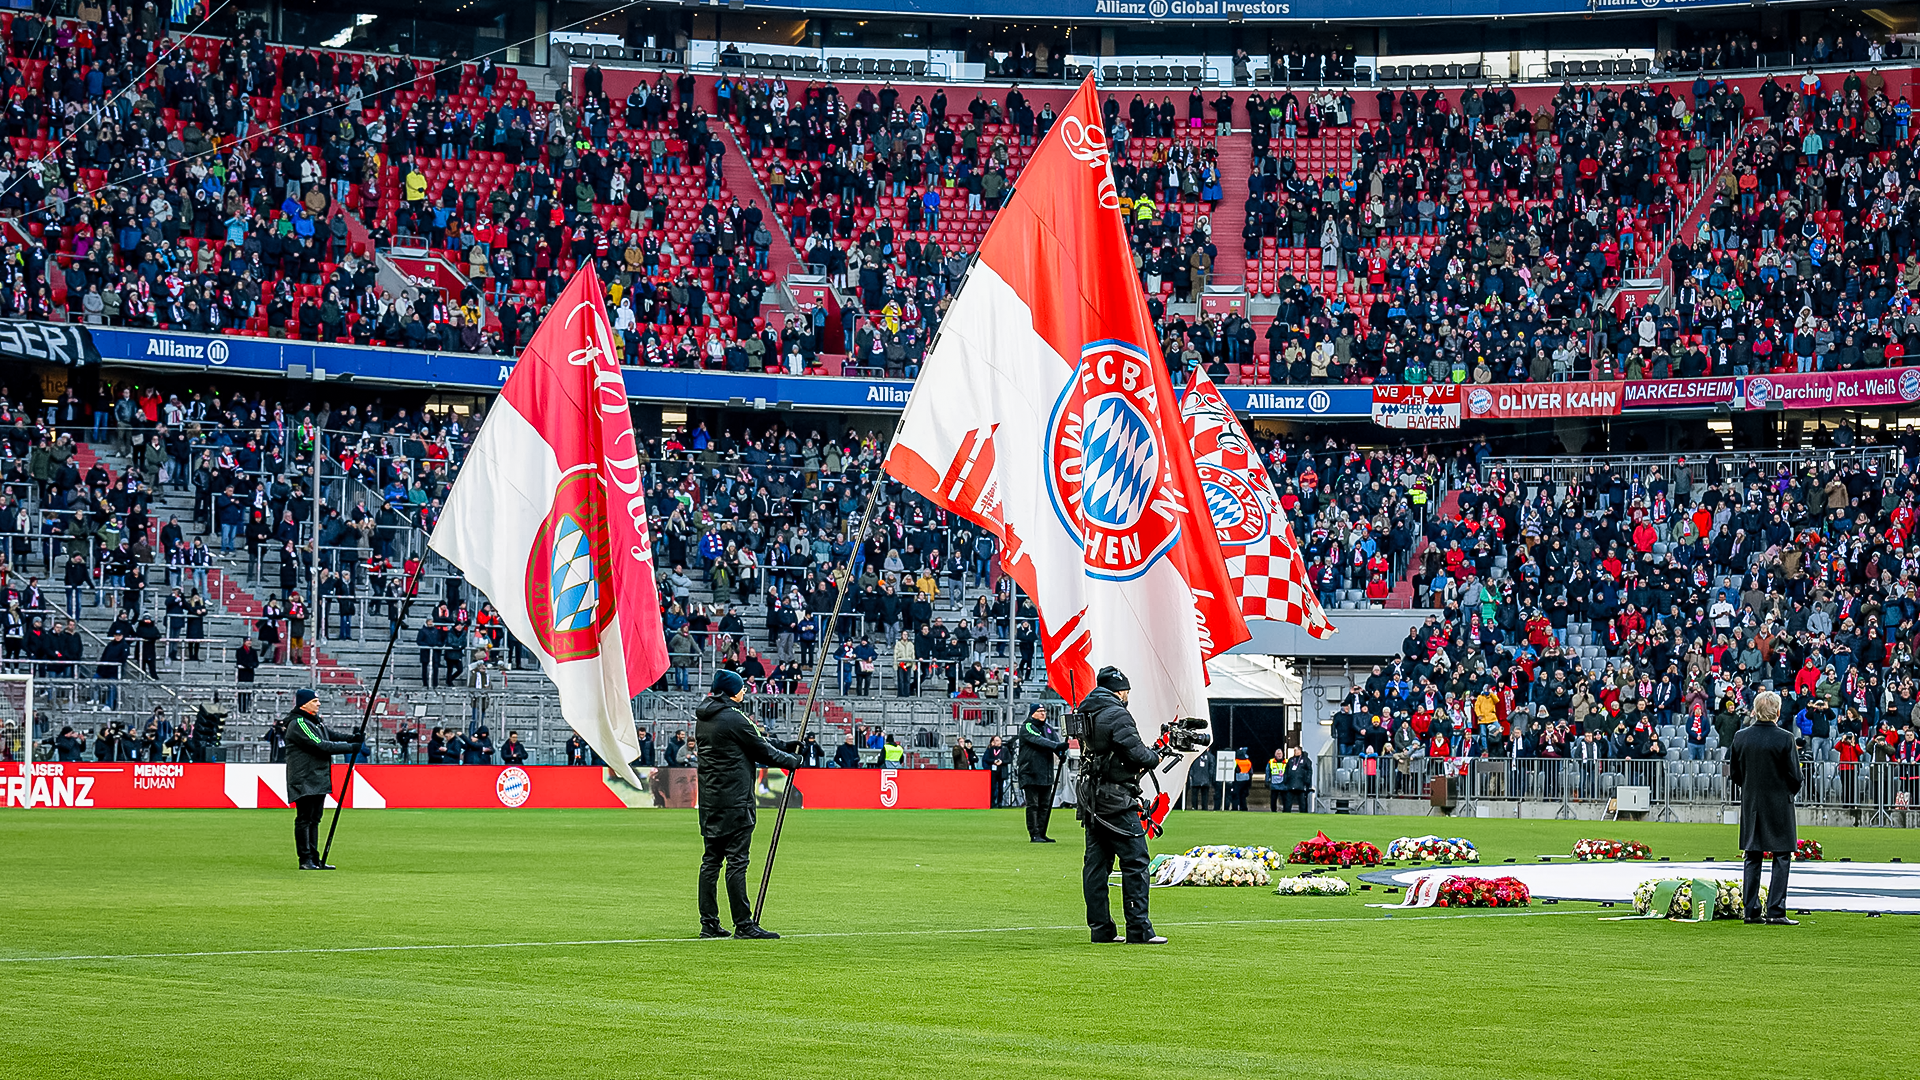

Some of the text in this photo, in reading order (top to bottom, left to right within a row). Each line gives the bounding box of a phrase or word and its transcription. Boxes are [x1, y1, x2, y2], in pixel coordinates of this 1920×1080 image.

[1096, 1, 1290, 14] Allianz Global Investors
[147, 338, 204, 359] Allianz
[1625, 381, 1733, 401] MARKELSHEIM
[1774, 378, 1896, 402] Darching Rot-Weiß
[1246, 393, 1304, 410] Allianz
[1498, 391, 1616, 411] OLIVER KAHN
[1217, 473, 1262, 536] BAYERN
[134, 765, 183, 777] MENSCH
[134, 778, 175, 789] HUMAN
[880, 769, 898, 807] 5
